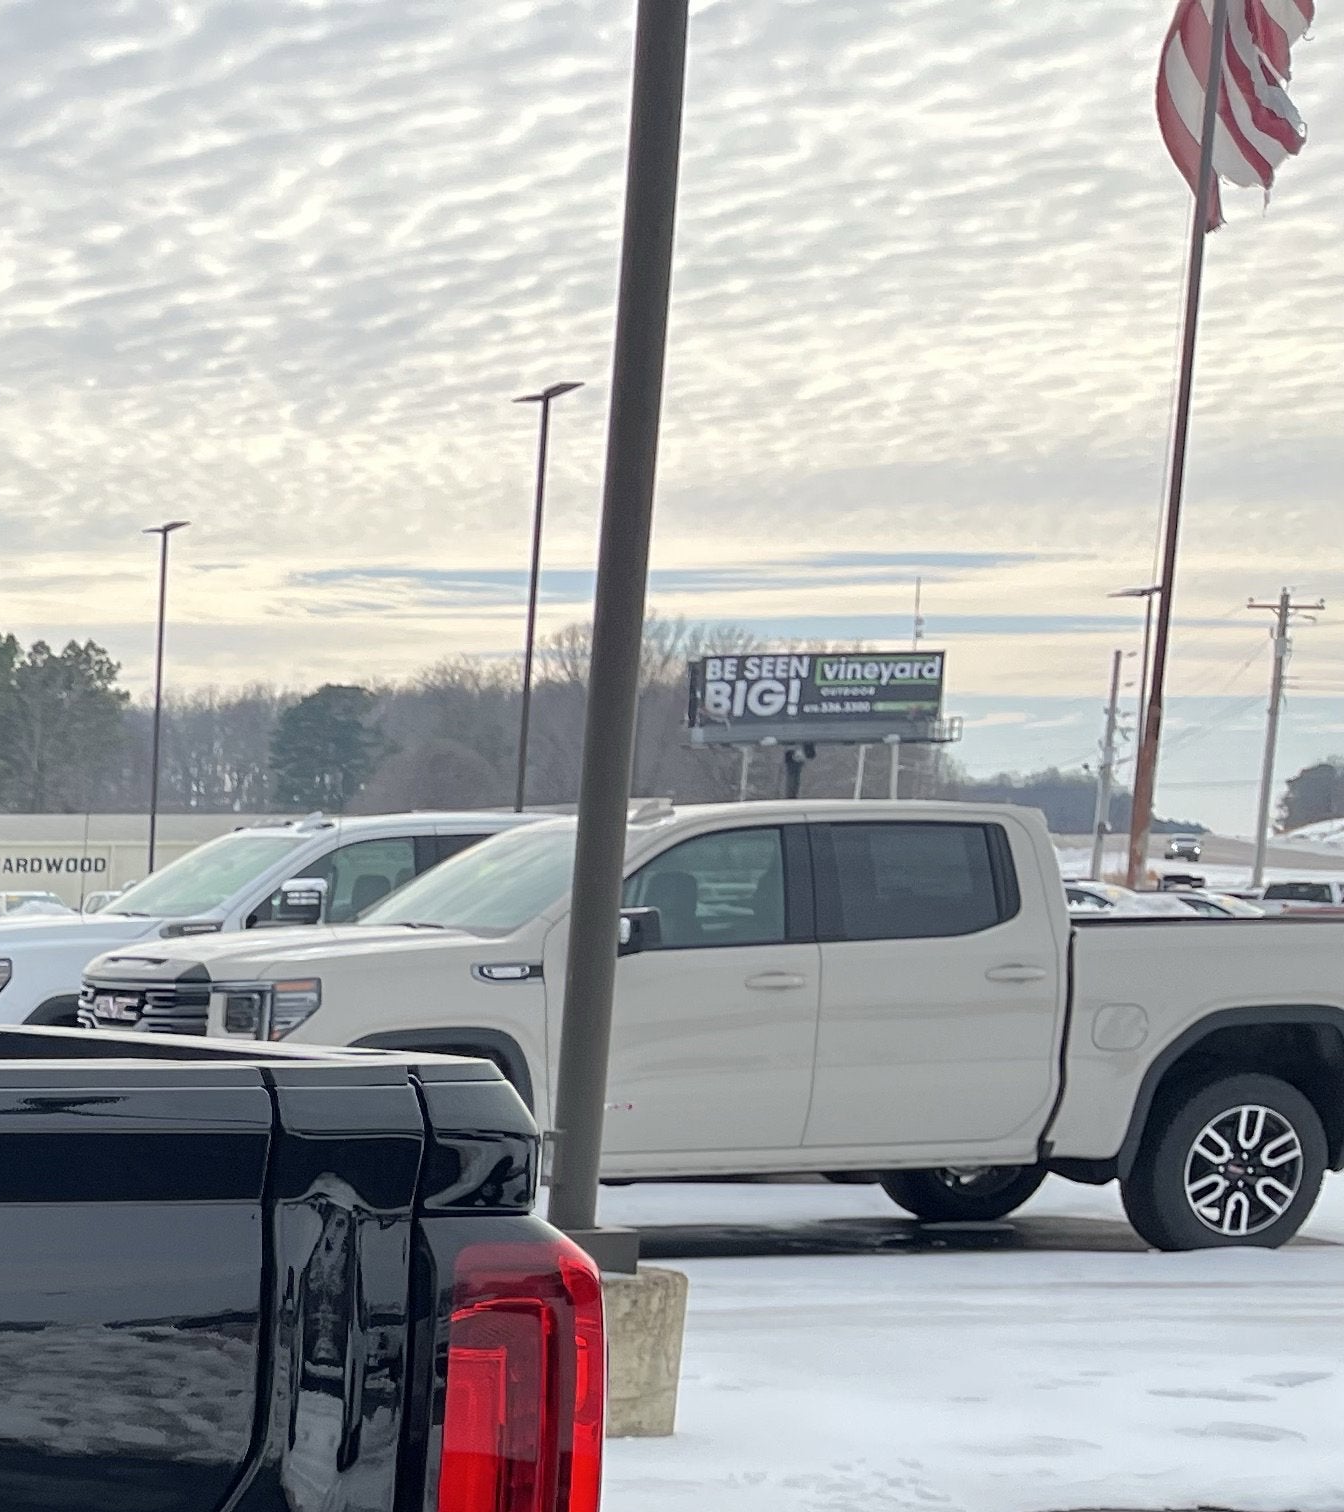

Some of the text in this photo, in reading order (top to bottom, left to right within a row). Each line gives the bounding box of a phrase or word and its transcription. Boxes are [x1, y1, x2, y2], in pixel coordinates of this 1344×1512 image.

[706, 656, 810, 680] BE SEEN
[823, 656, 941, 685] vineyard
[705, 679, 801, 718] BIG!
